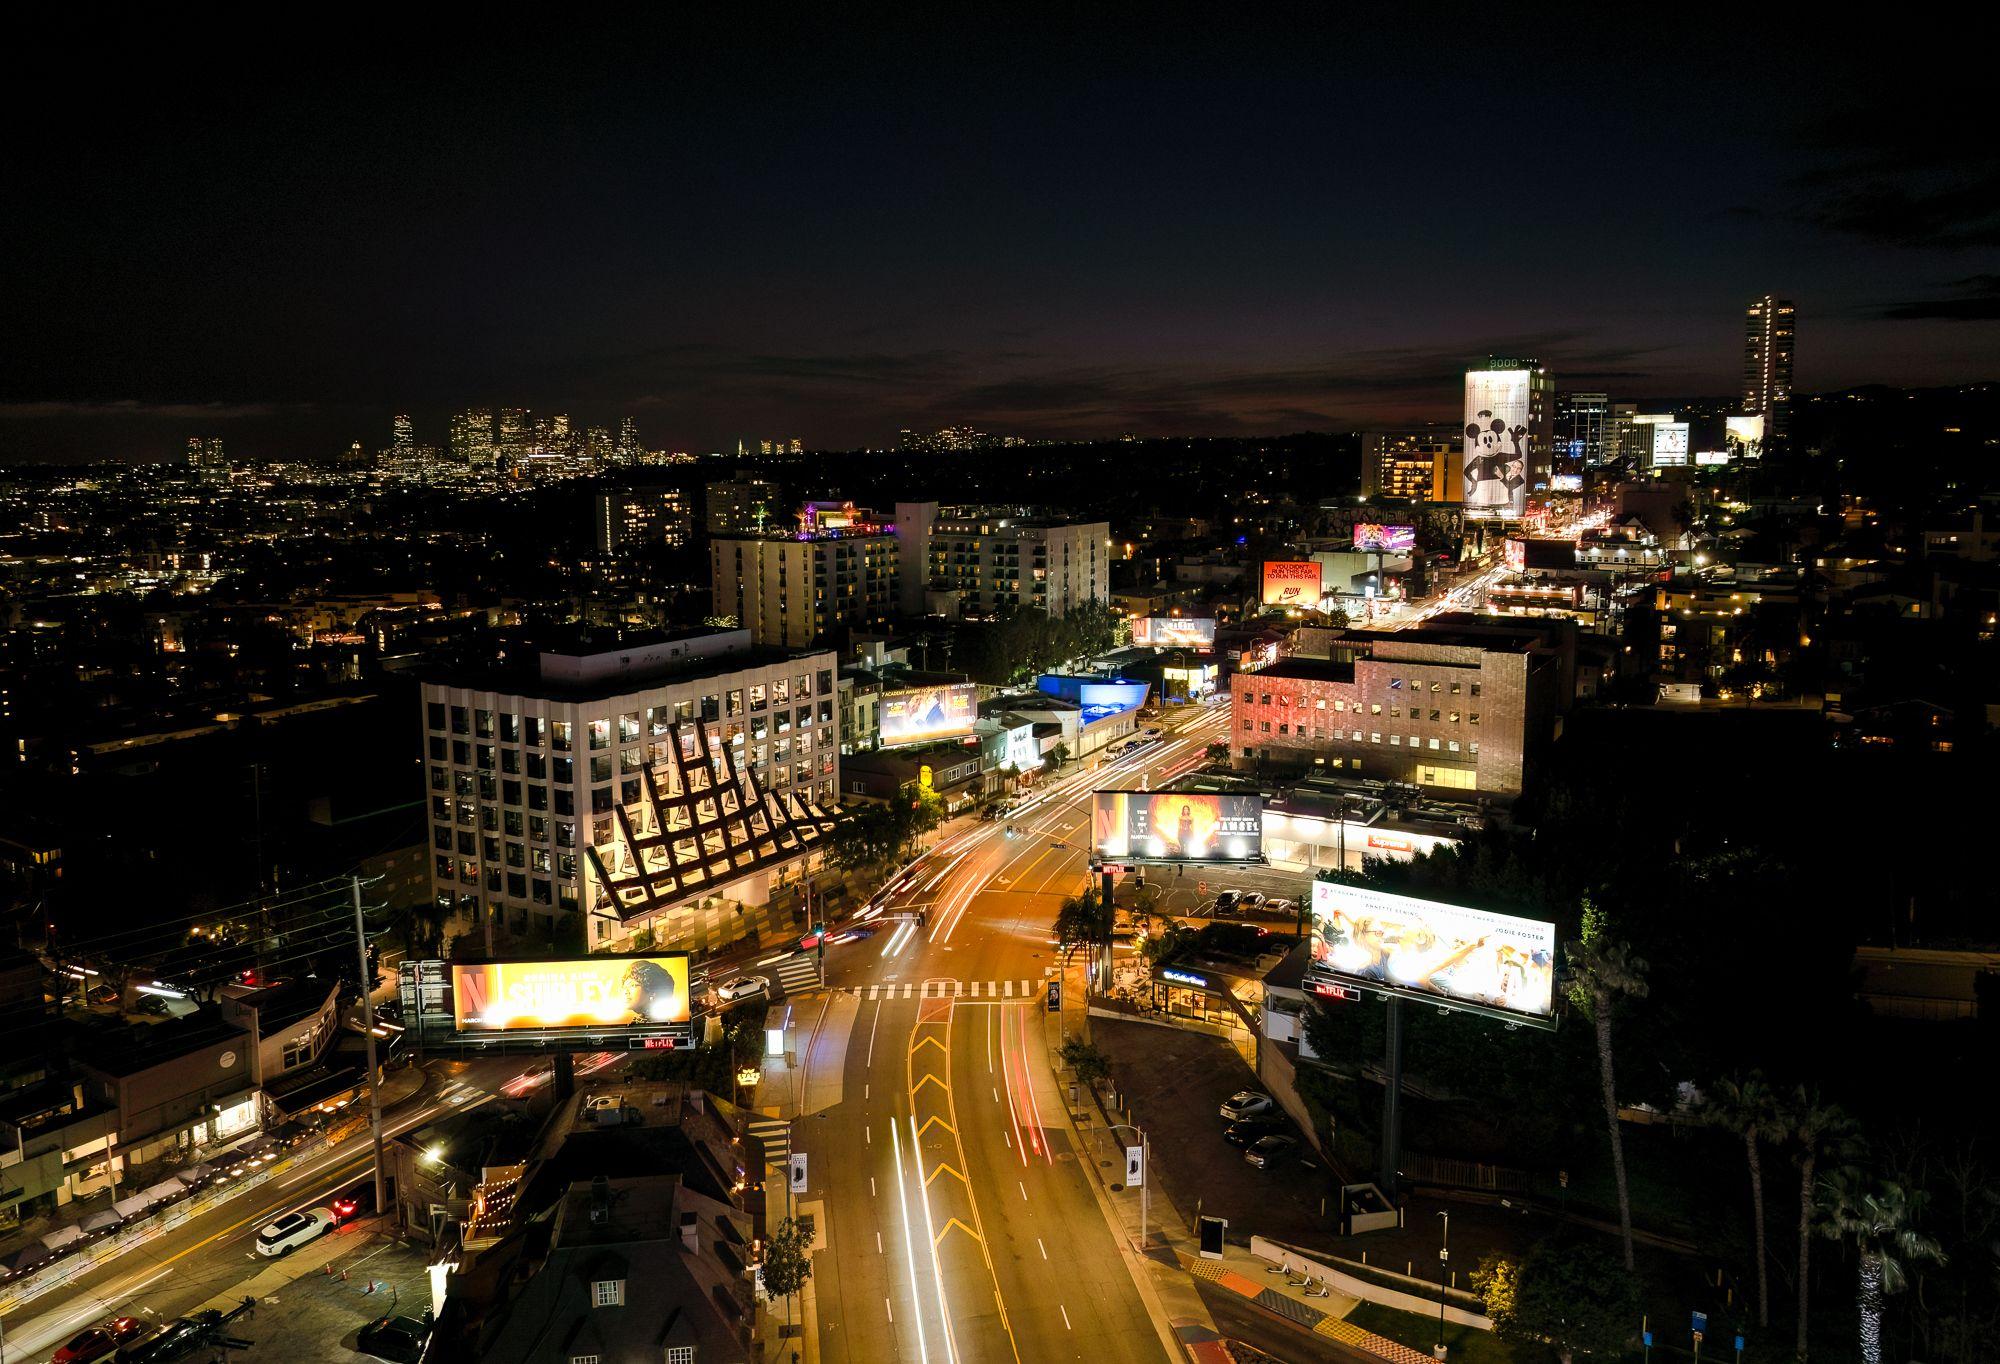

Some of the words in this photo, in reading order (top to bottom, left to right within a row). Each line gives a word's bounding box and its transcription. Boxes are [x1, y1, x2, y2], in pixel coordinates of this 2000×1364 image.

[1490, 359, 1518, 368] 9000
[1283, 587, 1301, 595] RUN
[1098, 809, 1116, 840] N
[1320, 887, 1329, 899] 2
[1495, 927, 1515, 936] JODIE
[1517, 931, 1545, 941] FOSTER
[460, 973, 487, 1013] N
[1316, 985, 1345, 998] NETFLIX
[645, 1038, 674, 1048] NETFLIX
